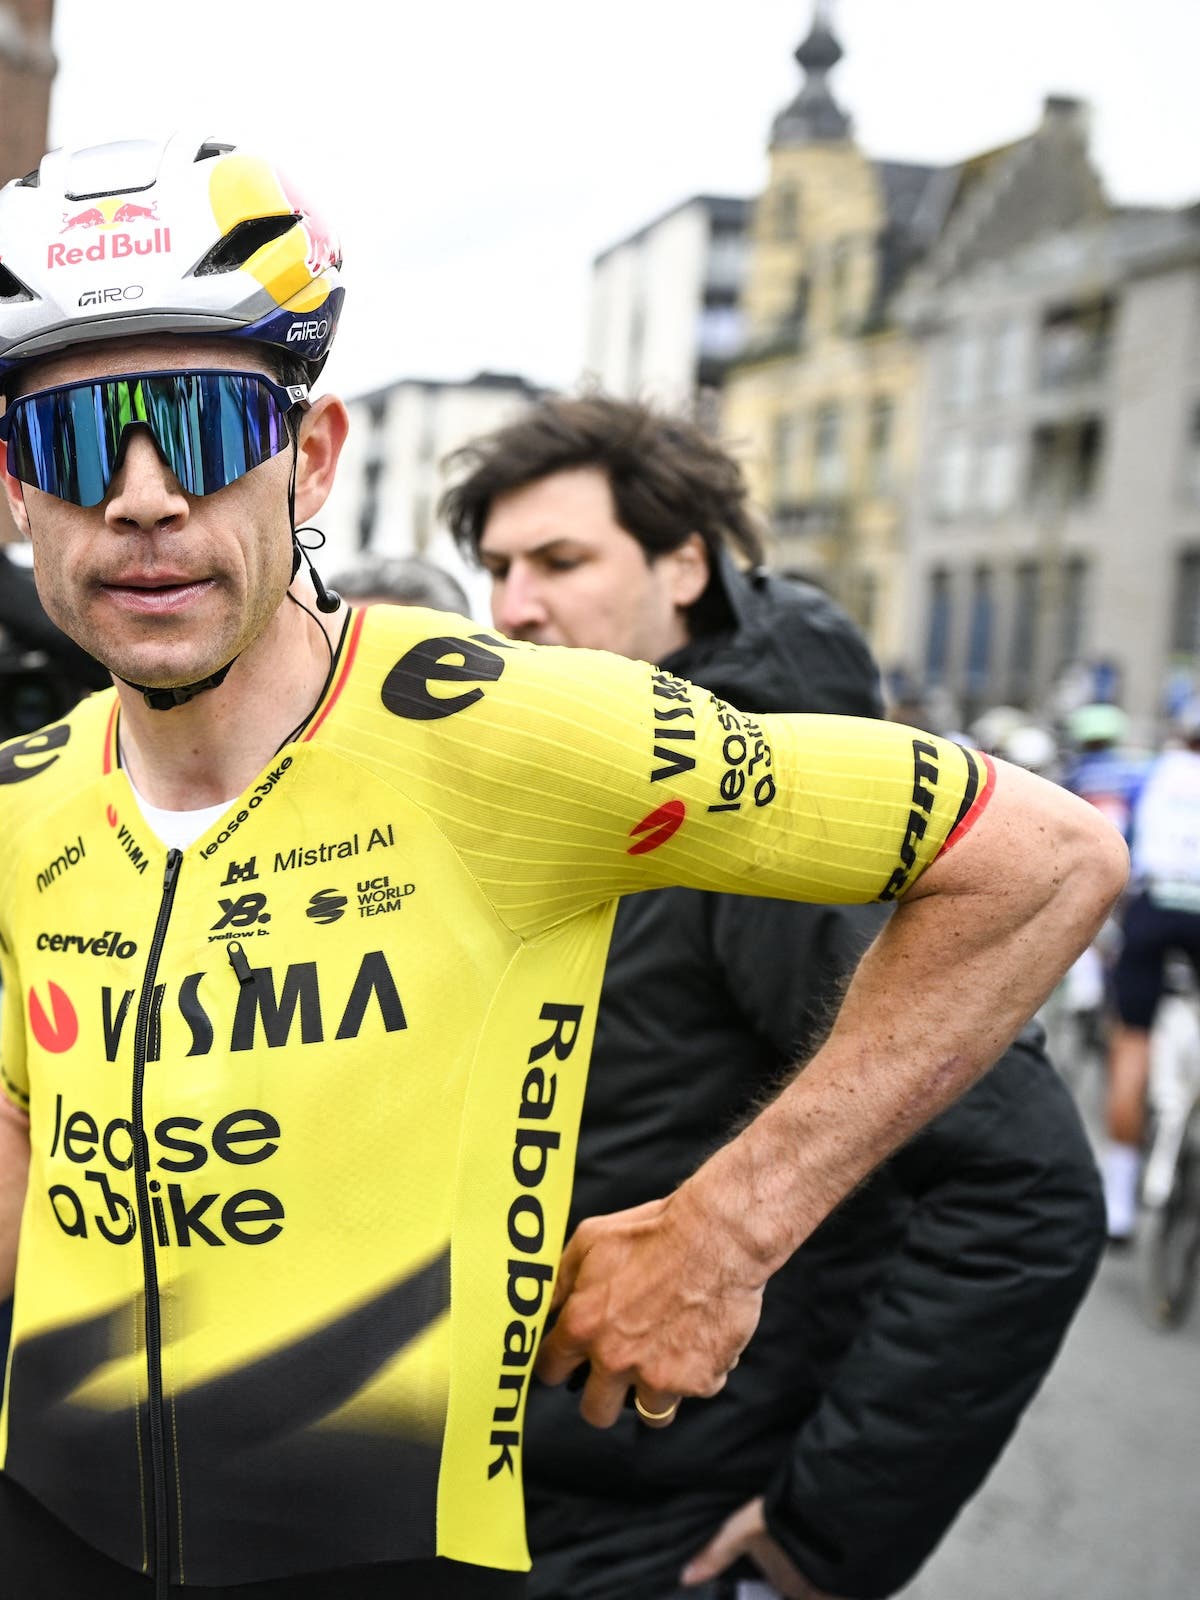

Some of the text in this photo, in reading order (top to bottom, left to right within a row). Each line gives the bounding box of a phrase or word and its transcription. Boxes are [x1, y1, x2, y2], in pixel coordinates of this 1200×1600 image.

[47, 228, 171, 269] Red Bull
[78, 285, 144, 307] GIRO
[286, 320, 328, 342] GIRO
[117, 824, 149, 875] VISMA
[199, 810, 250, 861] lease
[273, 824, 395, 873] Mistral AI
[36, 836, 87, 894] nimbl
[357, 876, 390, 893] UCI
[357, 883, 416, 906] WORLD
[357, 899, 402, 918] TEAM
[36, 930, 138, 960] cervélo
[207, 931, 255, 944] yellow
[101, 950, 408, 1062] VISMA
[50, 1093, 282, 1173] lease
[487, 1002, 585, 1481] Rabobank
